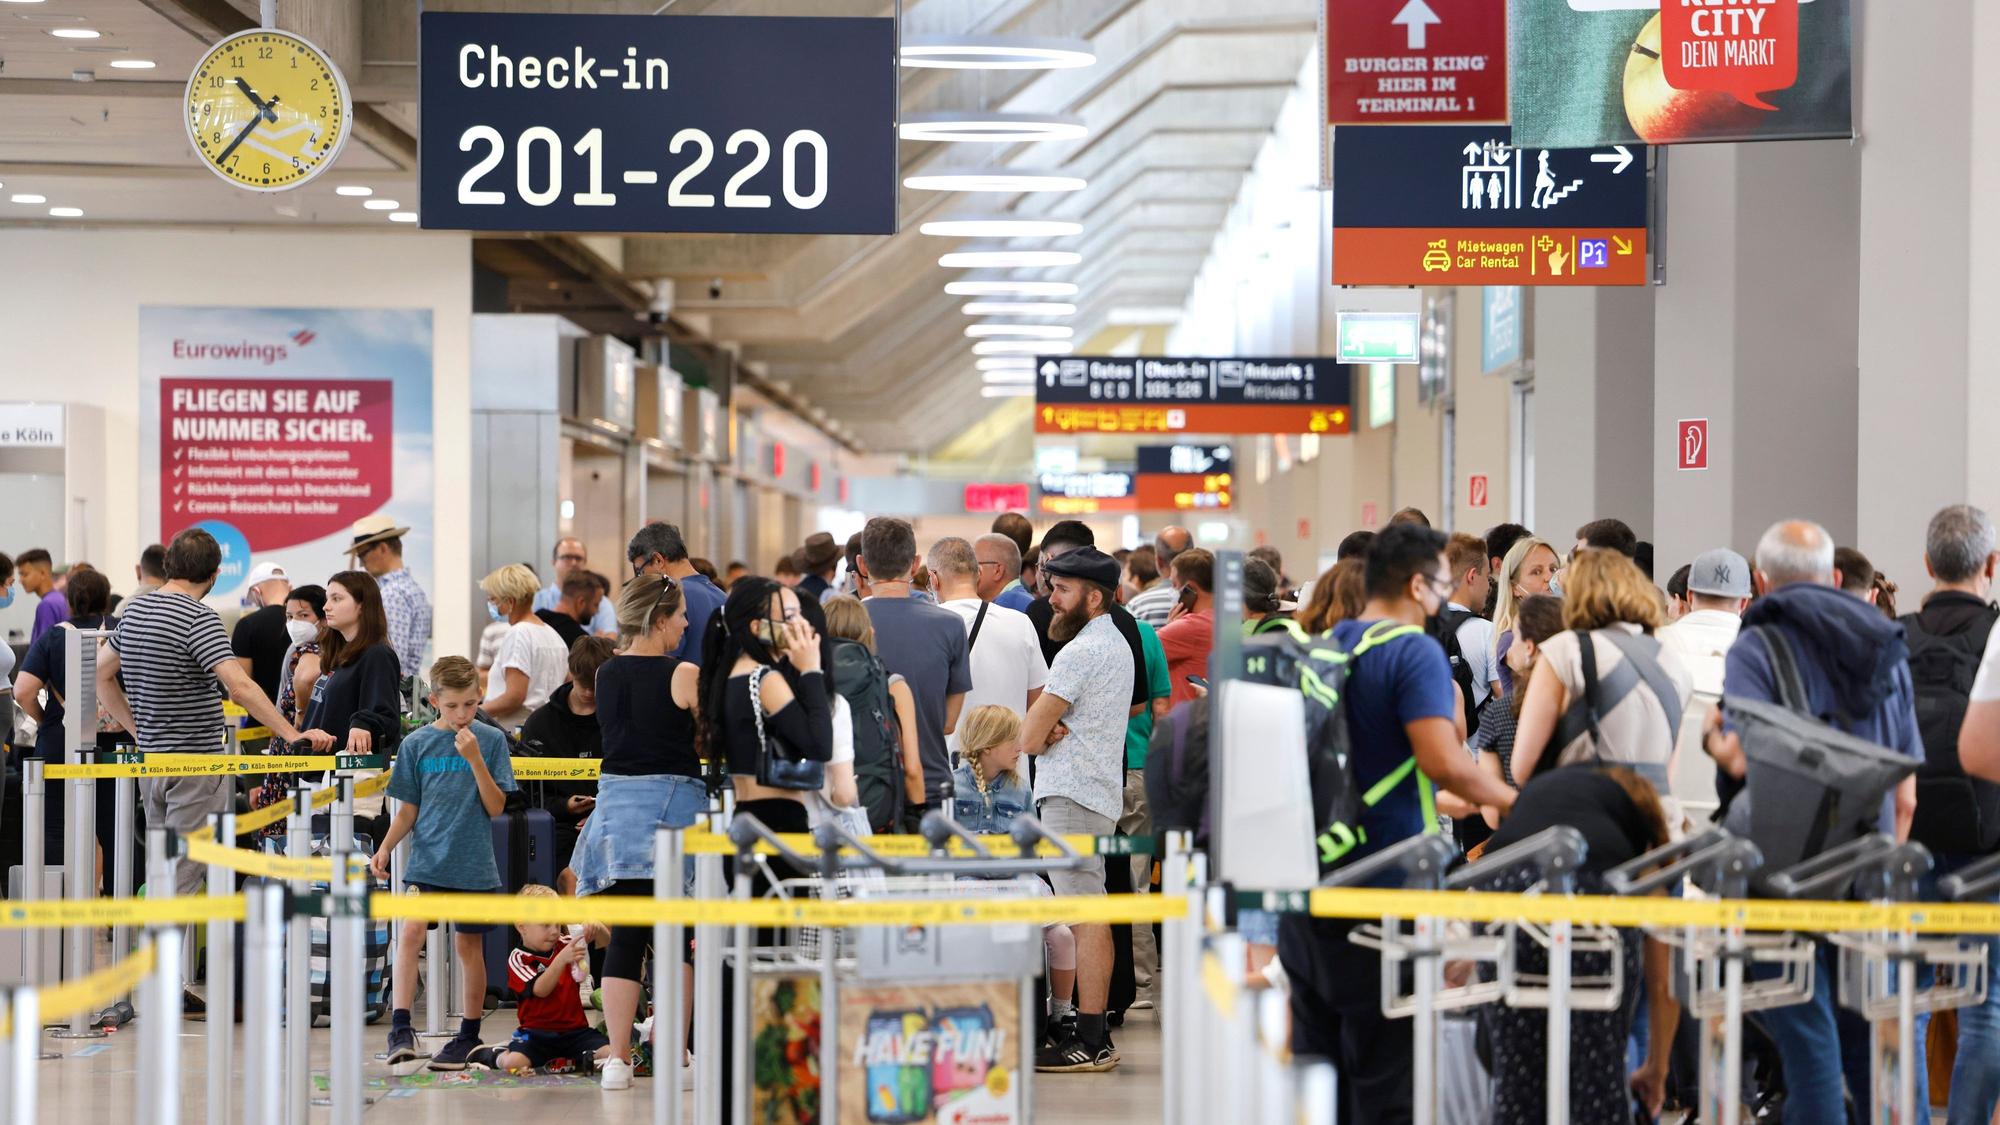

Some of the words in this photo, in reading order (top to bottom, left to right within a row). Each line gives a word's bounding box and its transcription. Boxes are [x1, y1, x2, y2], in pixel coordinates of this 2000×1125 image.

[1690, 8, 1767, 37] CITY
[258, 47, 273, 60] 12
[1681, 40, 1718, 68] DEIN
[1725, 38, 1776, 67] MARKT
[231, 56, 245, 68] 11
[290, 56, 298, 69] 1
[459, 43, 670, 91] Check-in
[1344, 57, 1428, 73] BURGER
[209, 76, 225, 88] 10
[310, 79, 318, 91] 2
[1377, 77, 1427, 93] HIER
[1432, 76, 1456, 92] IM
[203, 104, 211, 116] 9
[1356, 96, 1461, 113] TERMINAL
[1467, 97, 1475, 112] 1
[319, 106, 327, 118] 3
[213, 132, 221, 144] 8
[309, 133, 317, 144] 4
[232, 155, 240, 167] 7
[292, 156, 300, 168] 5
[458, 124, 829, 211] 201-220
[263, 162, 271, 175] 6
[1457, 240, 1524, 254] Mietwagen
[1457, 256, 1476, 269] Car
[1480, 255, 1519, 269] Rental
[172, 339, 288, 365] Eurowings
[172, 388, 267, 413] FLIEGEN
[272, 389, 309, 414] SIE
[313, 390, 361, 414] AUF
[16, 427, 54, 443] Köln
[172, 417, 281, 442] NUMMER
[284, 418, 374, 443] SICHER.
[187, 446, 229, 461] Flexible
[232, 447, 350, 465] Umbuchungsoptionen
[187, 464, 242, 479] Informiert
[244, 465, 263, 479] mit
[265, 464, 289, 479] dem
[291, 465, 359, 480] Reiseberater
[187, 482, 274, 500] Rückholgarantie
[275, 482, 302, 497] nach
[304, 482, 371, 498] Deutschland
[294, 500, 339, 515] buchbar
[149, 766, 164, 774] Köln
[183, 764, 208, 774] Airport
[251, 762, 265, 770] Köln
[285, 761, 309, 769] Airport
[544, 768, 567, 777] Airport
[853, 1029, 932, 1067] HAVE
[934, 1027, 1007, 1065] FUN!
